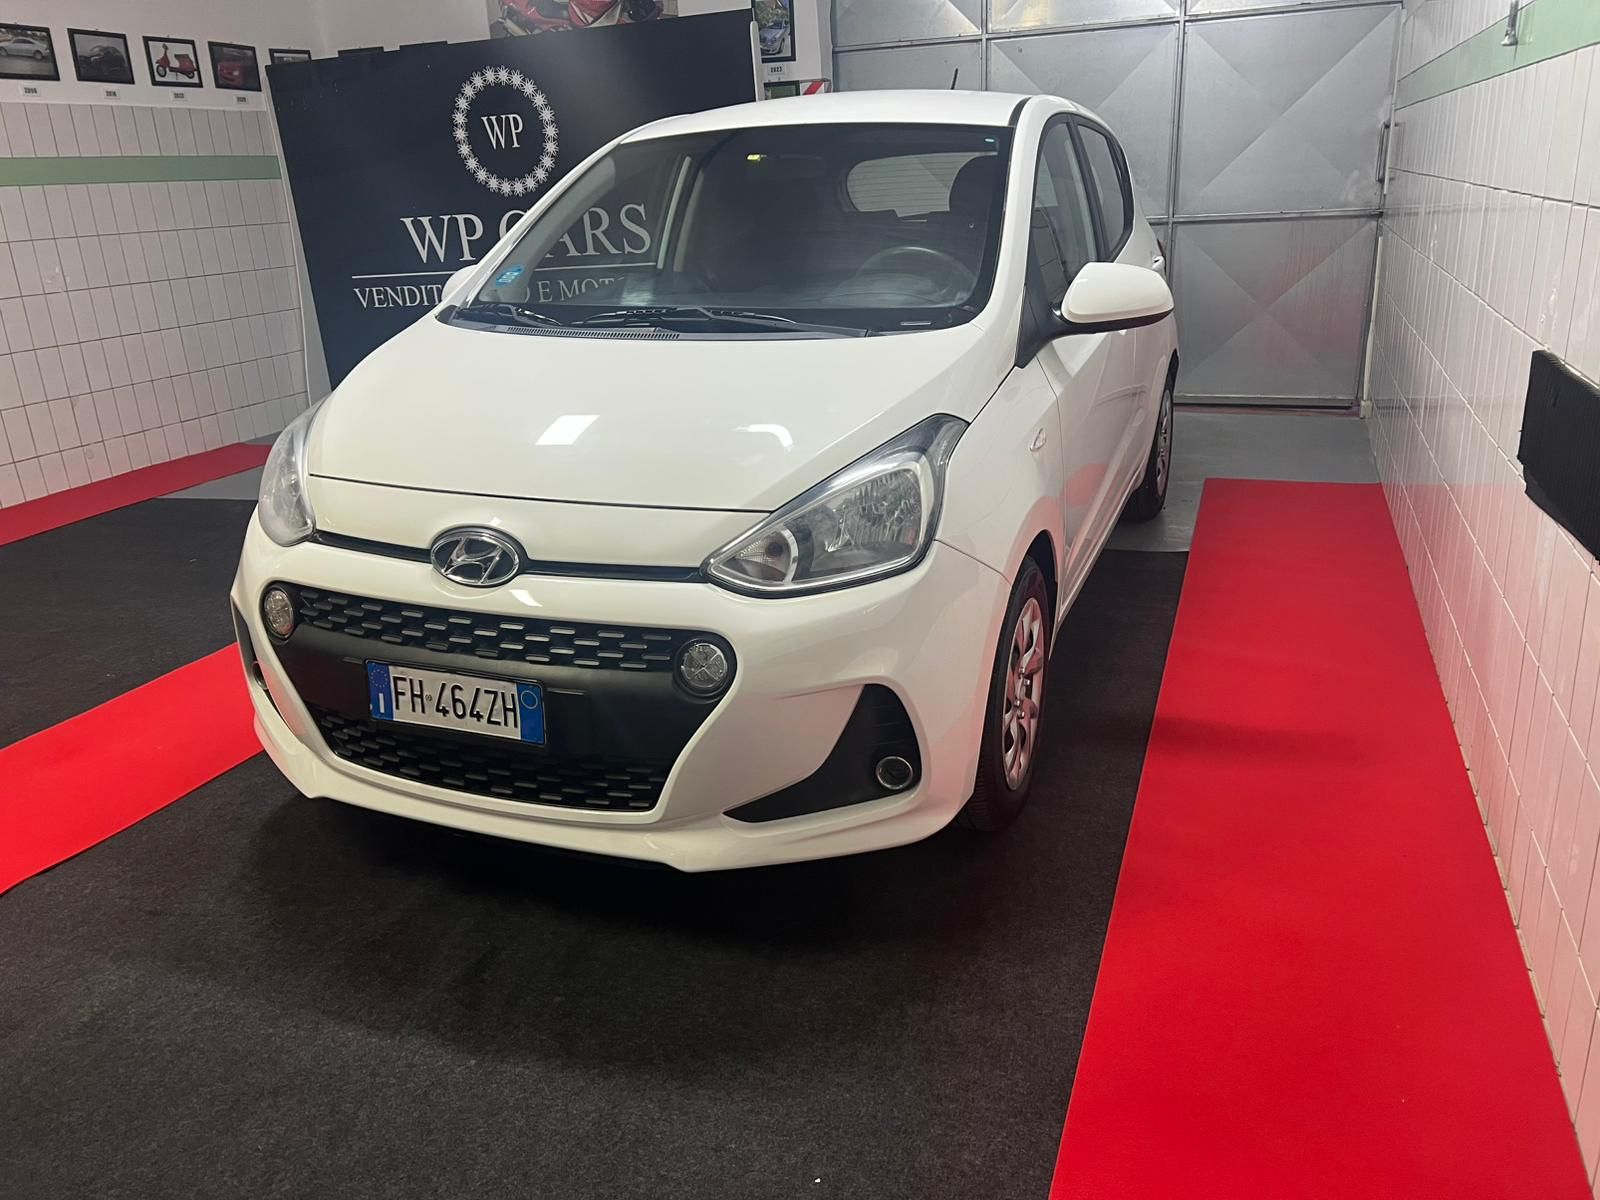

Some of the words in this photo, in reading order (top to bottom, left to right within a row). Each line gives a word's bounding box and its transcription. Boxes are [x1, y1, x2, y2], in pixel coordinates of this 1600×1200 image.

[481, 114, 523, 149] WP
[400, 213, 484, 263] WP
[353, 284, 443, 309] VENDIT
[537, 280, 553, 303] E
